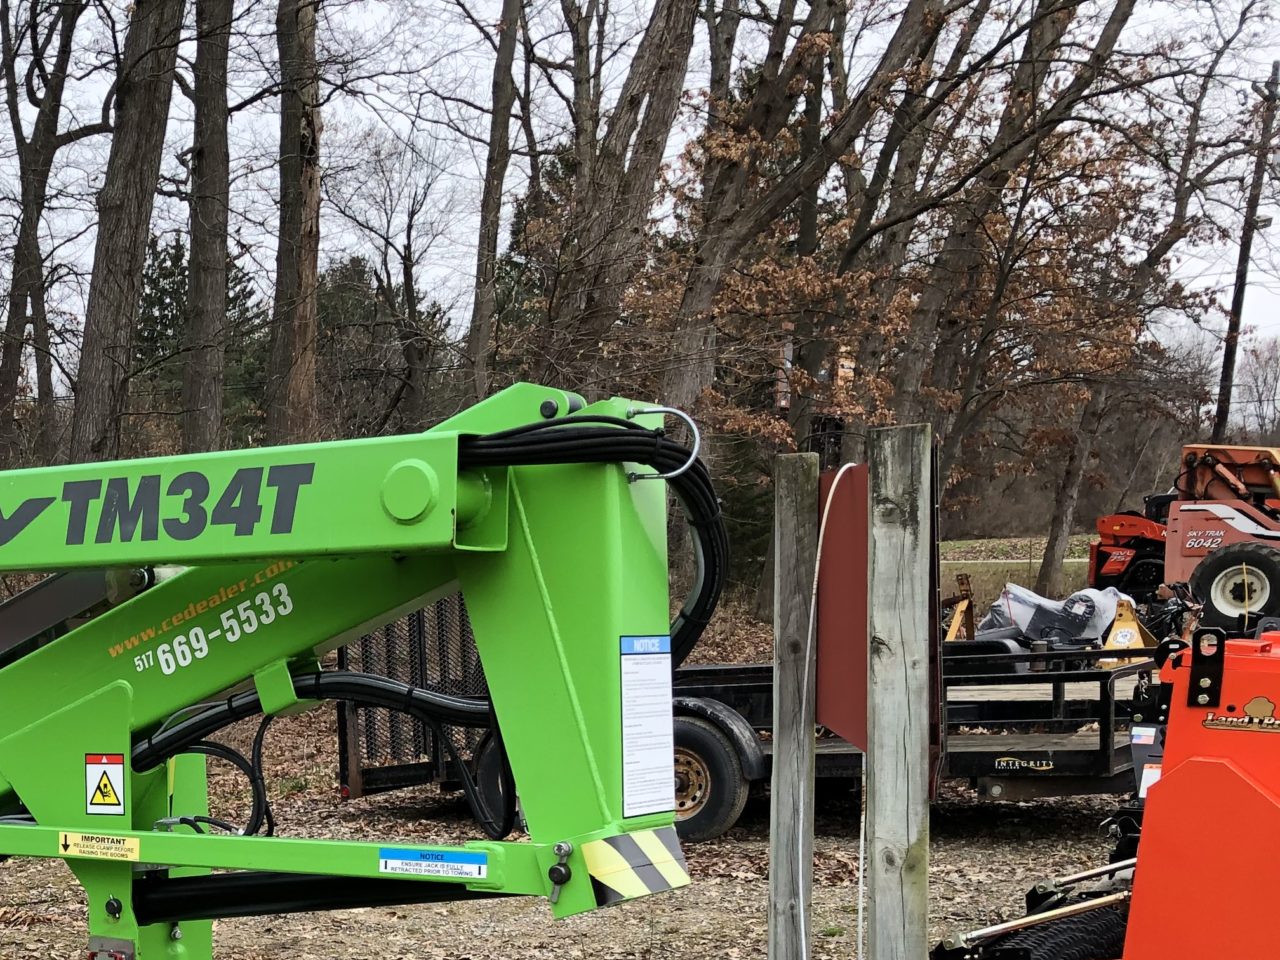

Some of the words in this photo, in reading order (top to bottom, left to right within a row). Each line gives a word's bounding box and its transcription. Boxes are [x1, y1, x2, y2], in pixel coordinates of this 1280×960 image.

[61, 462, 316, 545] TM34T
[1205, 529, 1225, 537] TRAK
[1185, 538, 1222, 548] 6042
[108, 560, 295, 657] www.cedealer.com
[133, 650, 154, 672] 517
[156, 583, 293, 675] 669-5533
[633, 639, 660, 651] NOTICE
[1206, 712, 1250, 726] Land
[81, 835, 126, 845] IMPORTANT
